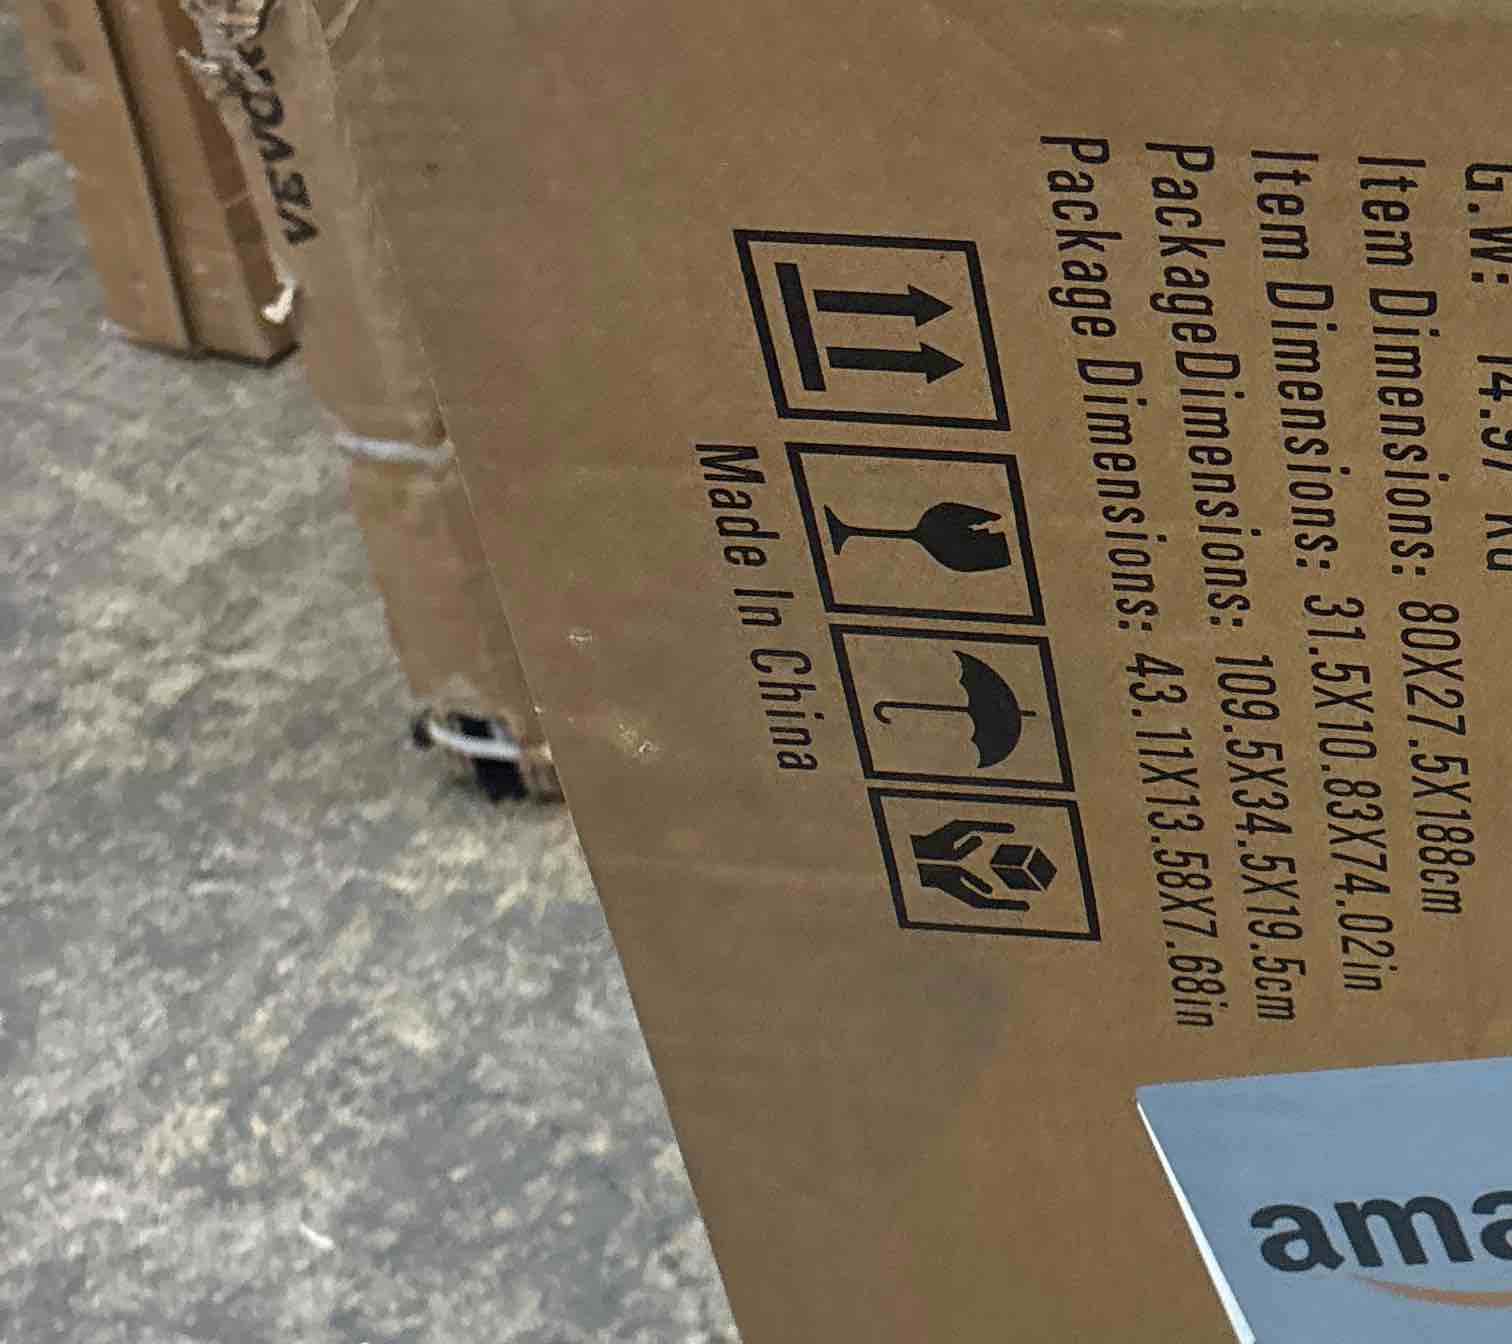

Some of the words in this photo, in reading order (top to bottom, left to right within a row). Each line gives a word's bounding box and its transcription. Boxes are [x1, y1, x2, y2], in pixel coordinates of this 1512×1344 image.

[1039, 134, 1123, 338] Package
[1250, 150, 1320, 261] Item
[1357, 155, 1427, 267] Item
[695, 443, 781, 569] Made
[1076, 357, 1168, 632] Dimensions:
[1265, 280, 1352, 570] Dimensions:
[1369, 287, 1451, 576] Dimensions:
[733, 587, 795, 627] In
[749, 647, 825, 771] China
[1125, 651, 1229, 1028] 43.11X13.58X7.68in
[1214, 653, 1308, 1023] 109.5X34.5X19.5cm
[1303, 593, 1400, 993] 31.5X10.83X74.02in
[1397, 599, 1477, 916] 80X27.5X188cm
